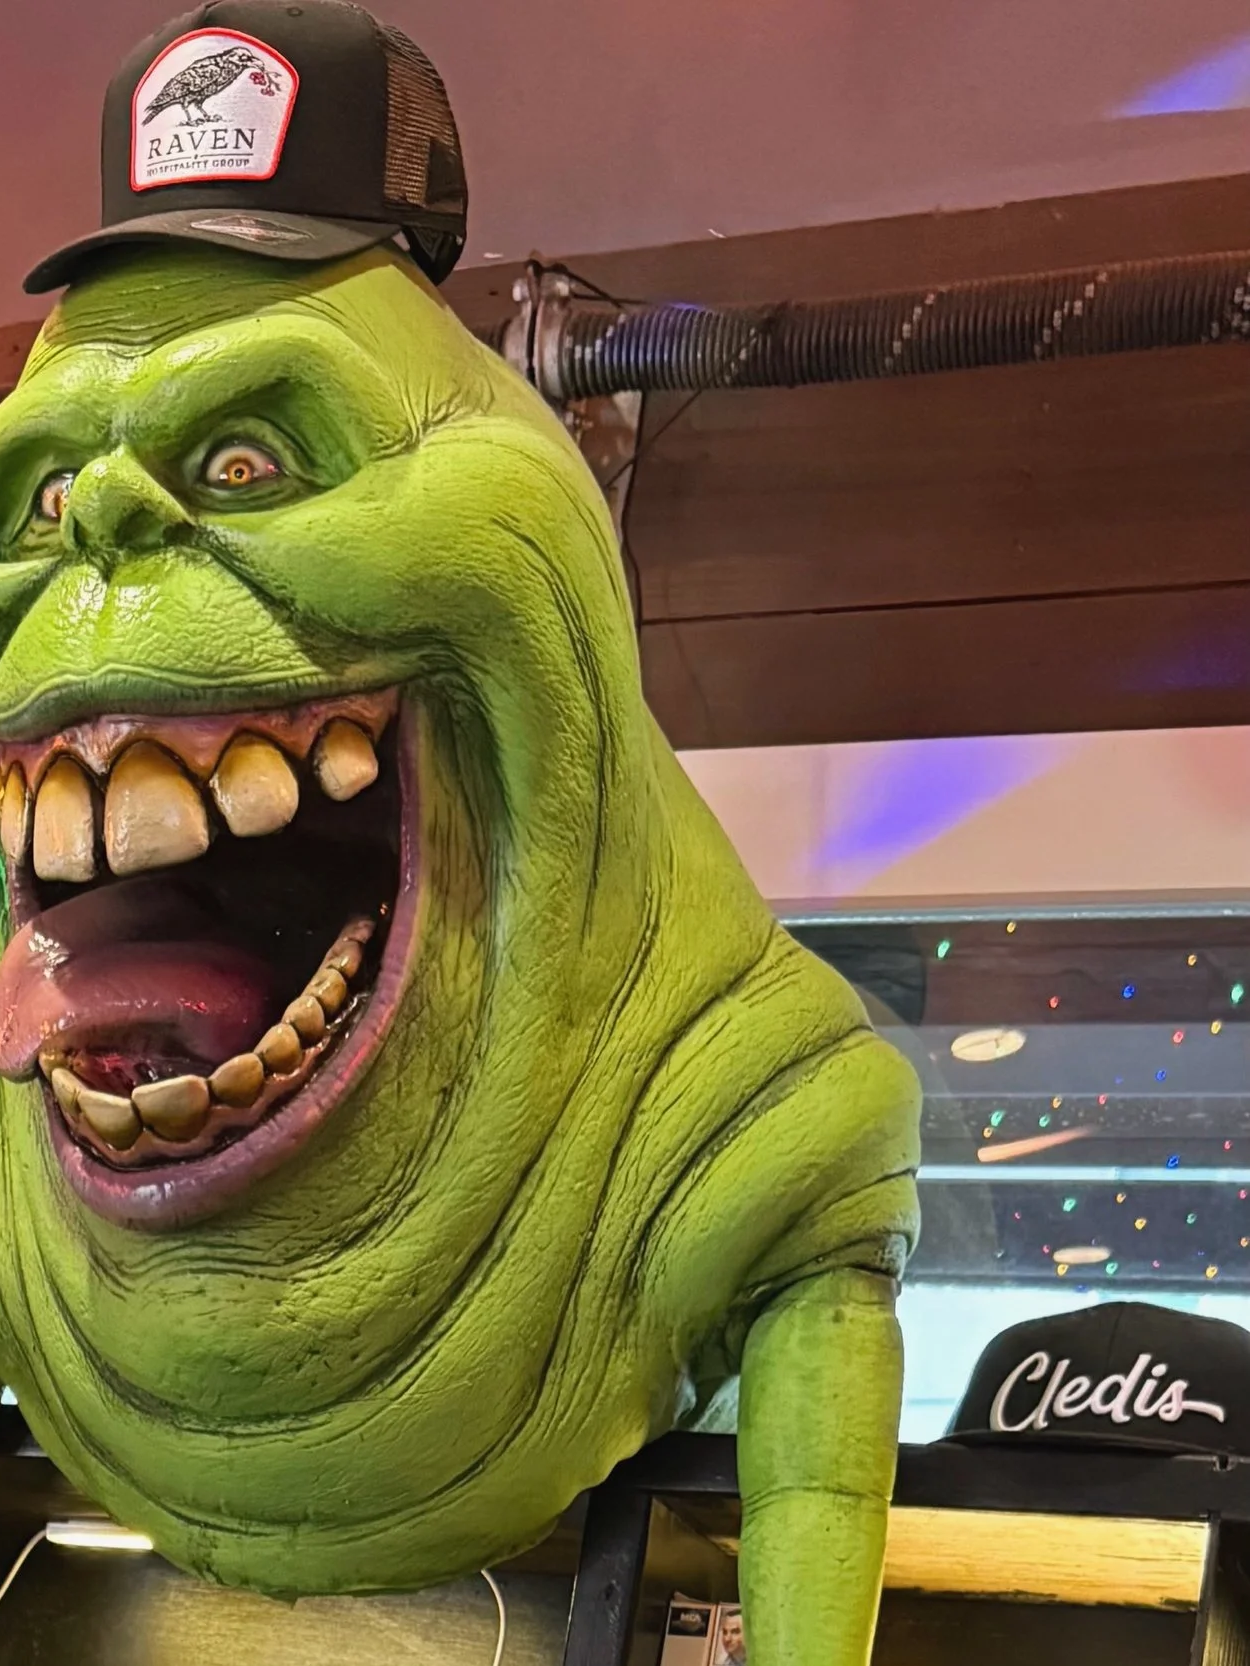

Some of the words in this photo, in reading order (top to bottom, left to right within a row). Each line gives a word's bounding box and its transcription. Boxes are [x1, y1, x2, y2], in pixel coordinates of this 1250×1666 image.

[148, 128, 256, 159] RAVEN
[147, 160, 208, 176] HOSPITALITY
[212, 158, 250, 168] GROUP
[989, 1351, 1225, 1433] Cledis
